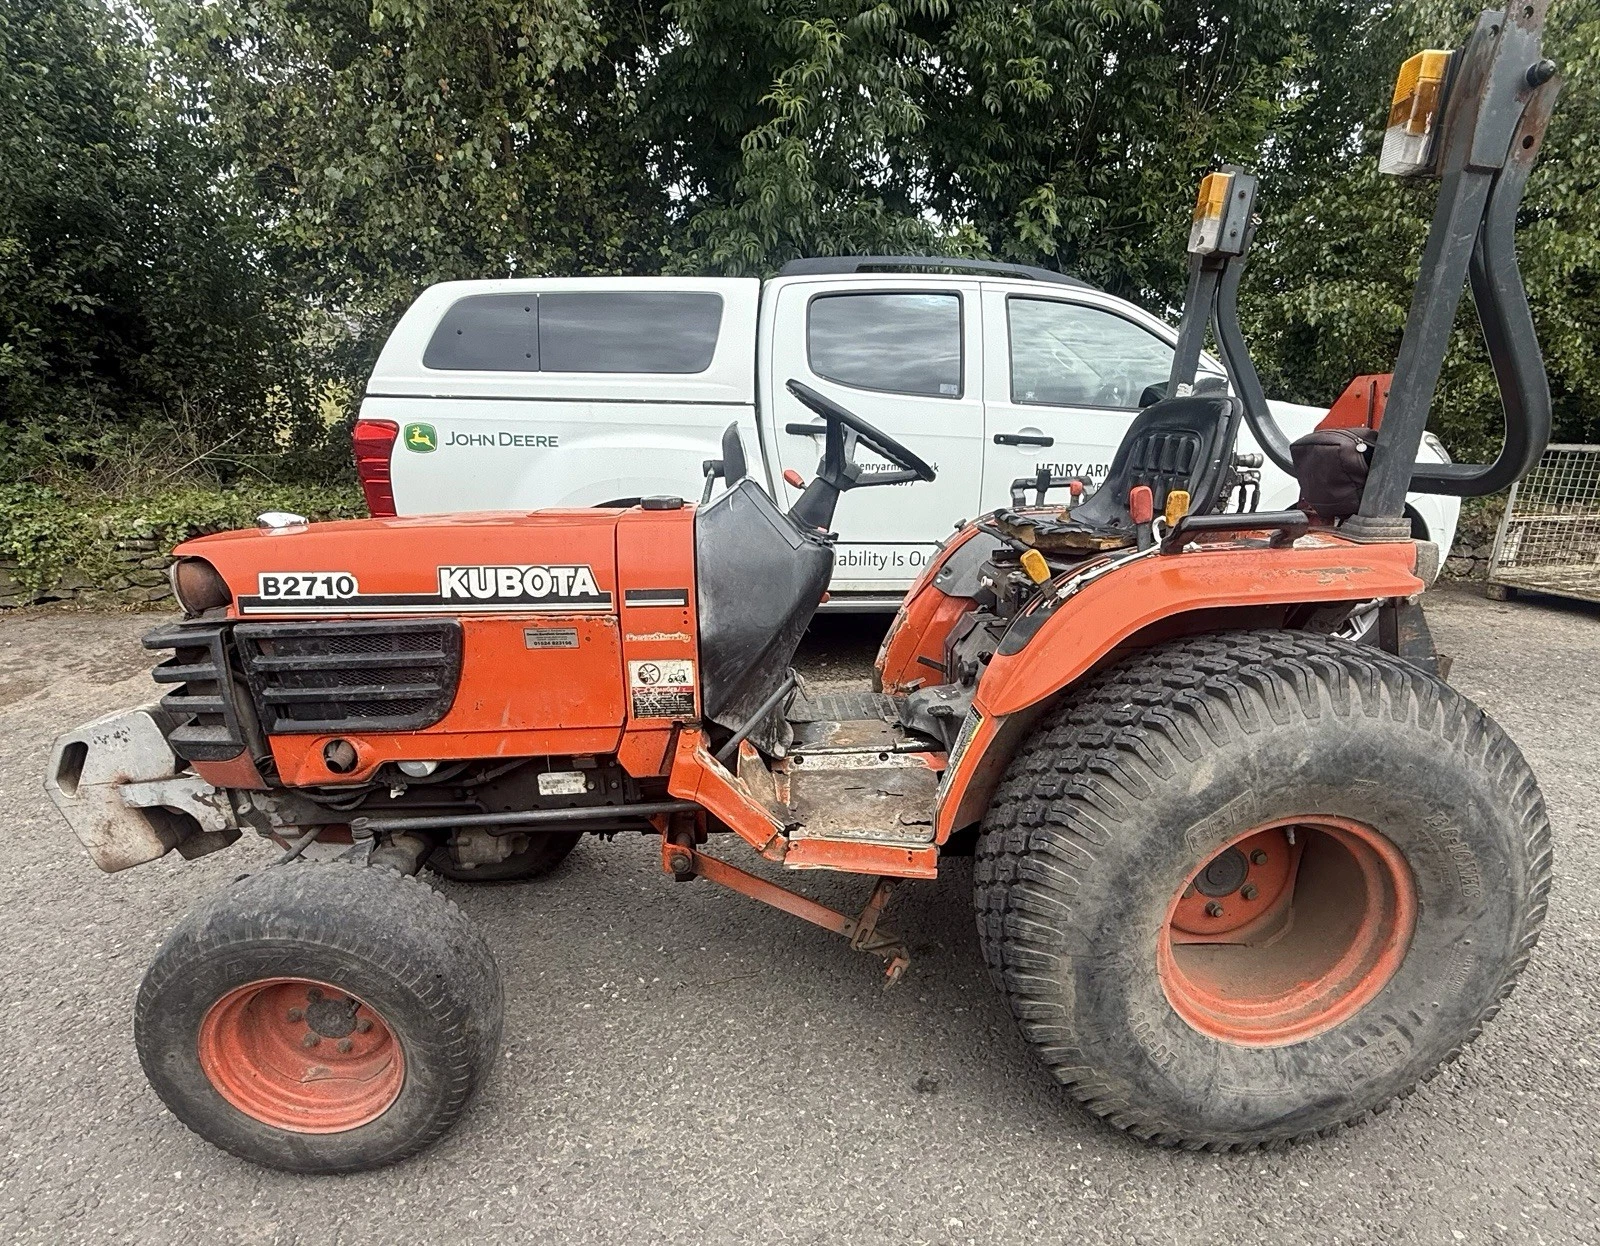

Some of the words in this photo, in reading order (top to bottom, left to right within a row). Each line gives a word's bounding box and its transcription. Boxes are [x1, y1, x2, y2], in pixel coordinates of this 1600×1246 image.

[445, 431, 495, 447] JOHN
[499, 432, 559, 448] DEERE
[1036, 463, 1083, 477] HENRY
[893, 551, 904, 566] Is
[262, 576, 355, 597] B2710
[440, 566, 600, 598] KUBOTA
